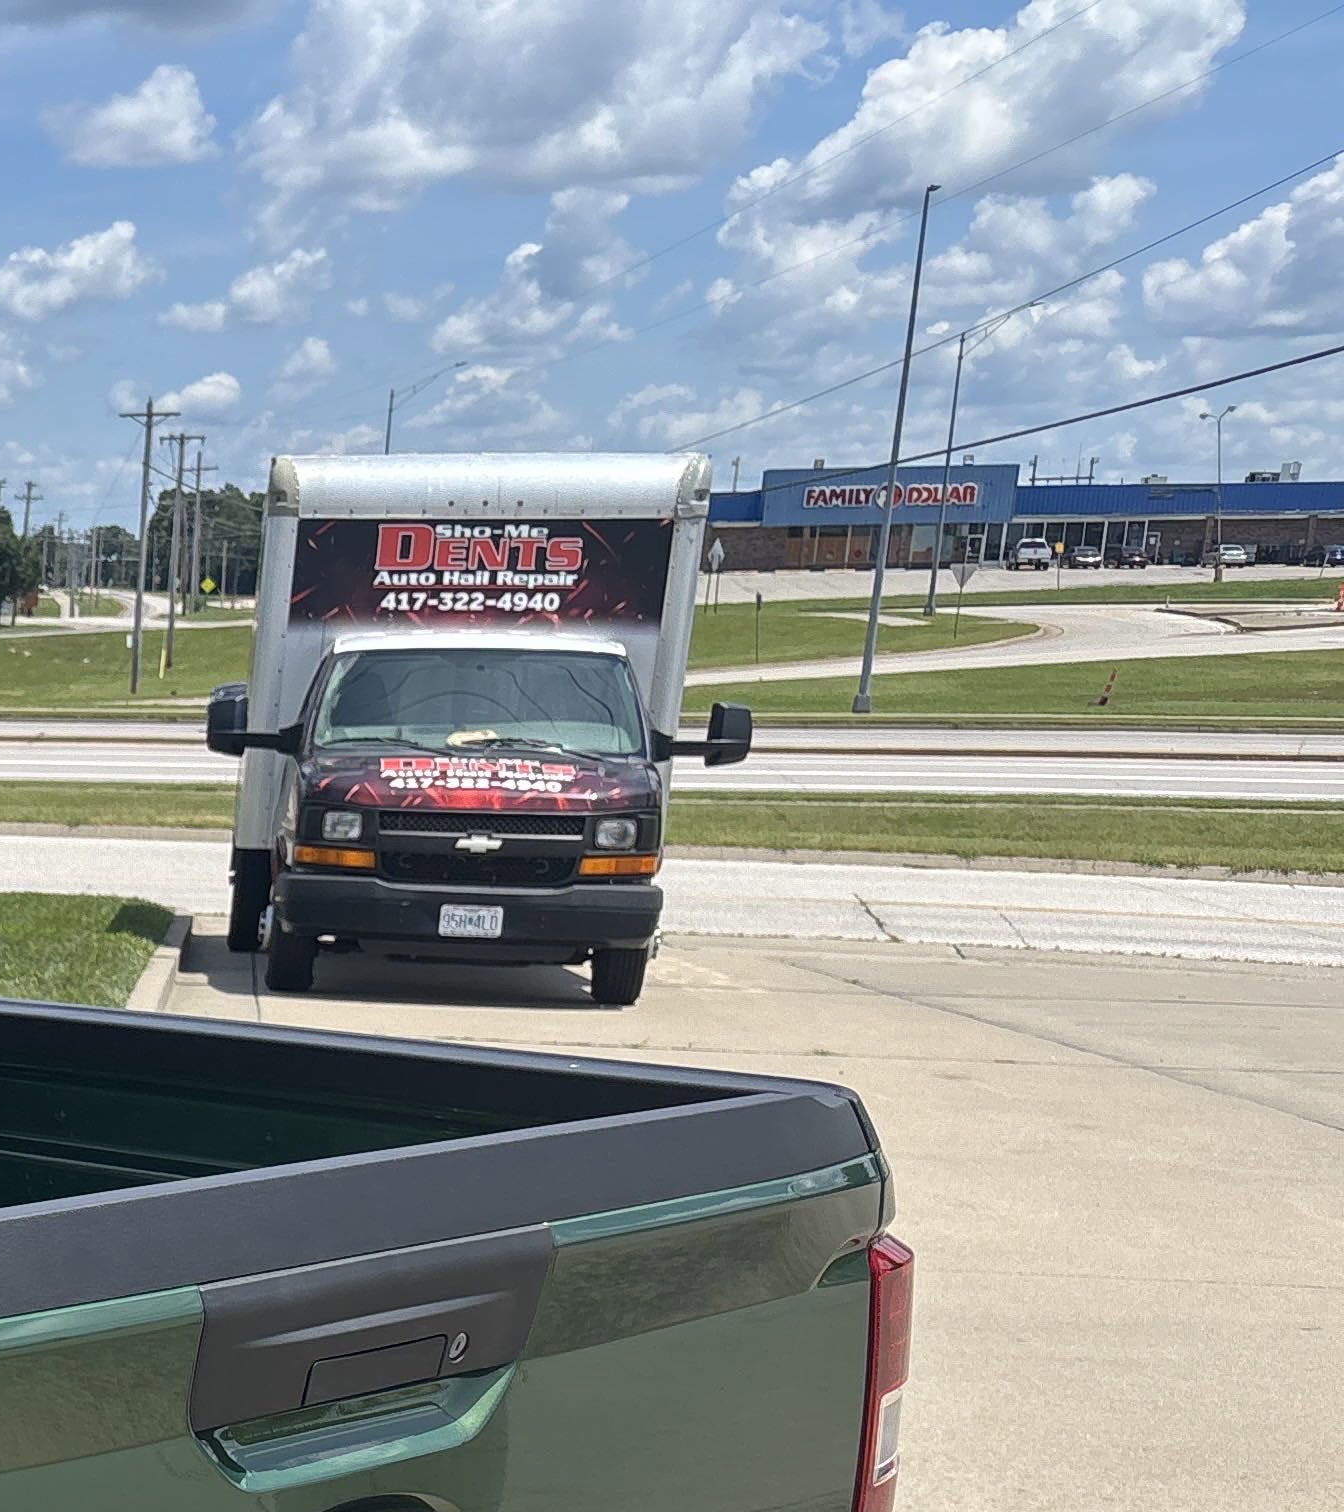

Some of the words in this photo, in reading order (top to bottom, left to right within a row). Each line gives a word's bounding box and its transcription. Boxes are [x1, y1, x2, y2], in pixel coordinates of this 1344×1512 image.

[803, 486, 876, 508] FAMILY
[435, 524, 549, 538] Sho-Me
[373, 571, 436, 586] Auto
[442, 571, 490, 586] Hail
[496, 571, 578, 589] Repair
[380, 591, 561, 611] 417-322-4940
